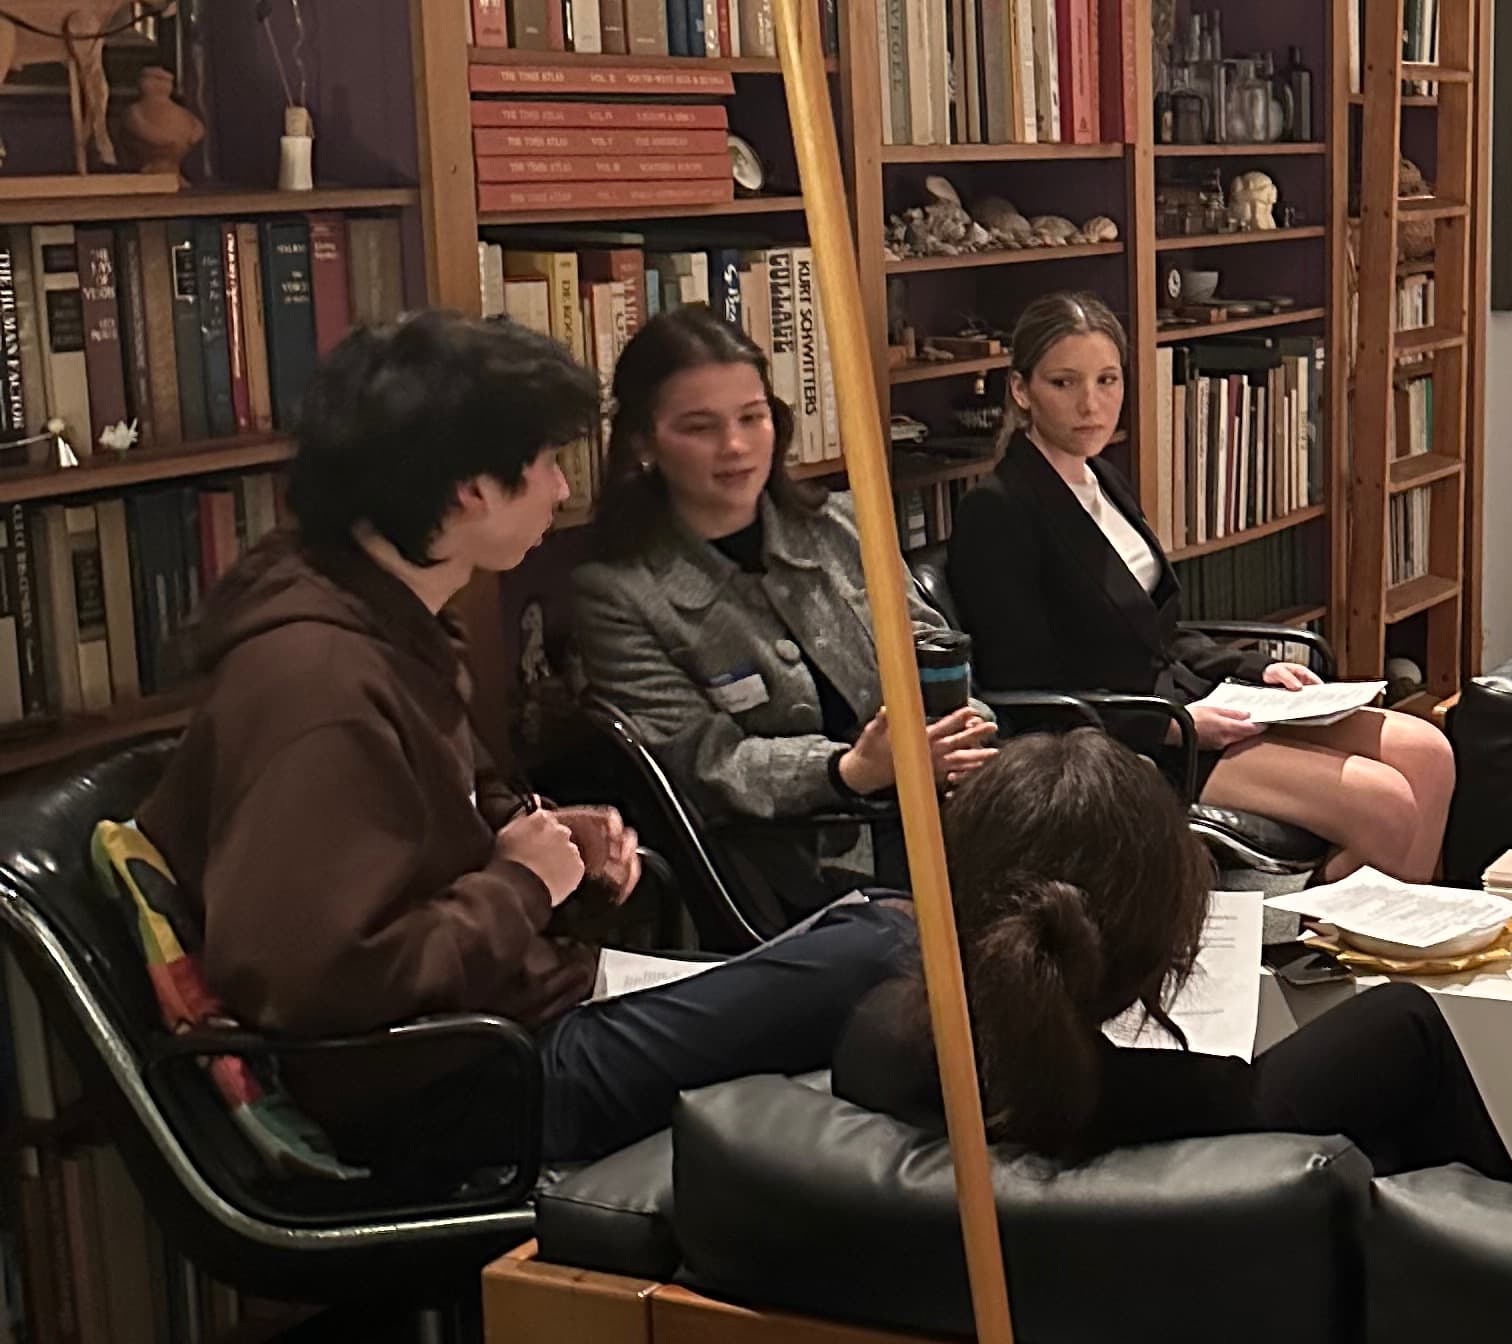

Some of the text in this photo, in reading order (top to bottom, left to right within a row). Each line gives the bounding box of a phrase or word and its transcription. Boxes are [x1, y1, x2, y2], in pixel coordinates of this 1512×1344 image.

[0, 288, 20, 355] HUMAN
[768, 253, 796, 354] COLLAGE
[796, 260, 818, 416] KURT SCHWITTERS
[7, 358, 25, 431] FACTOR
